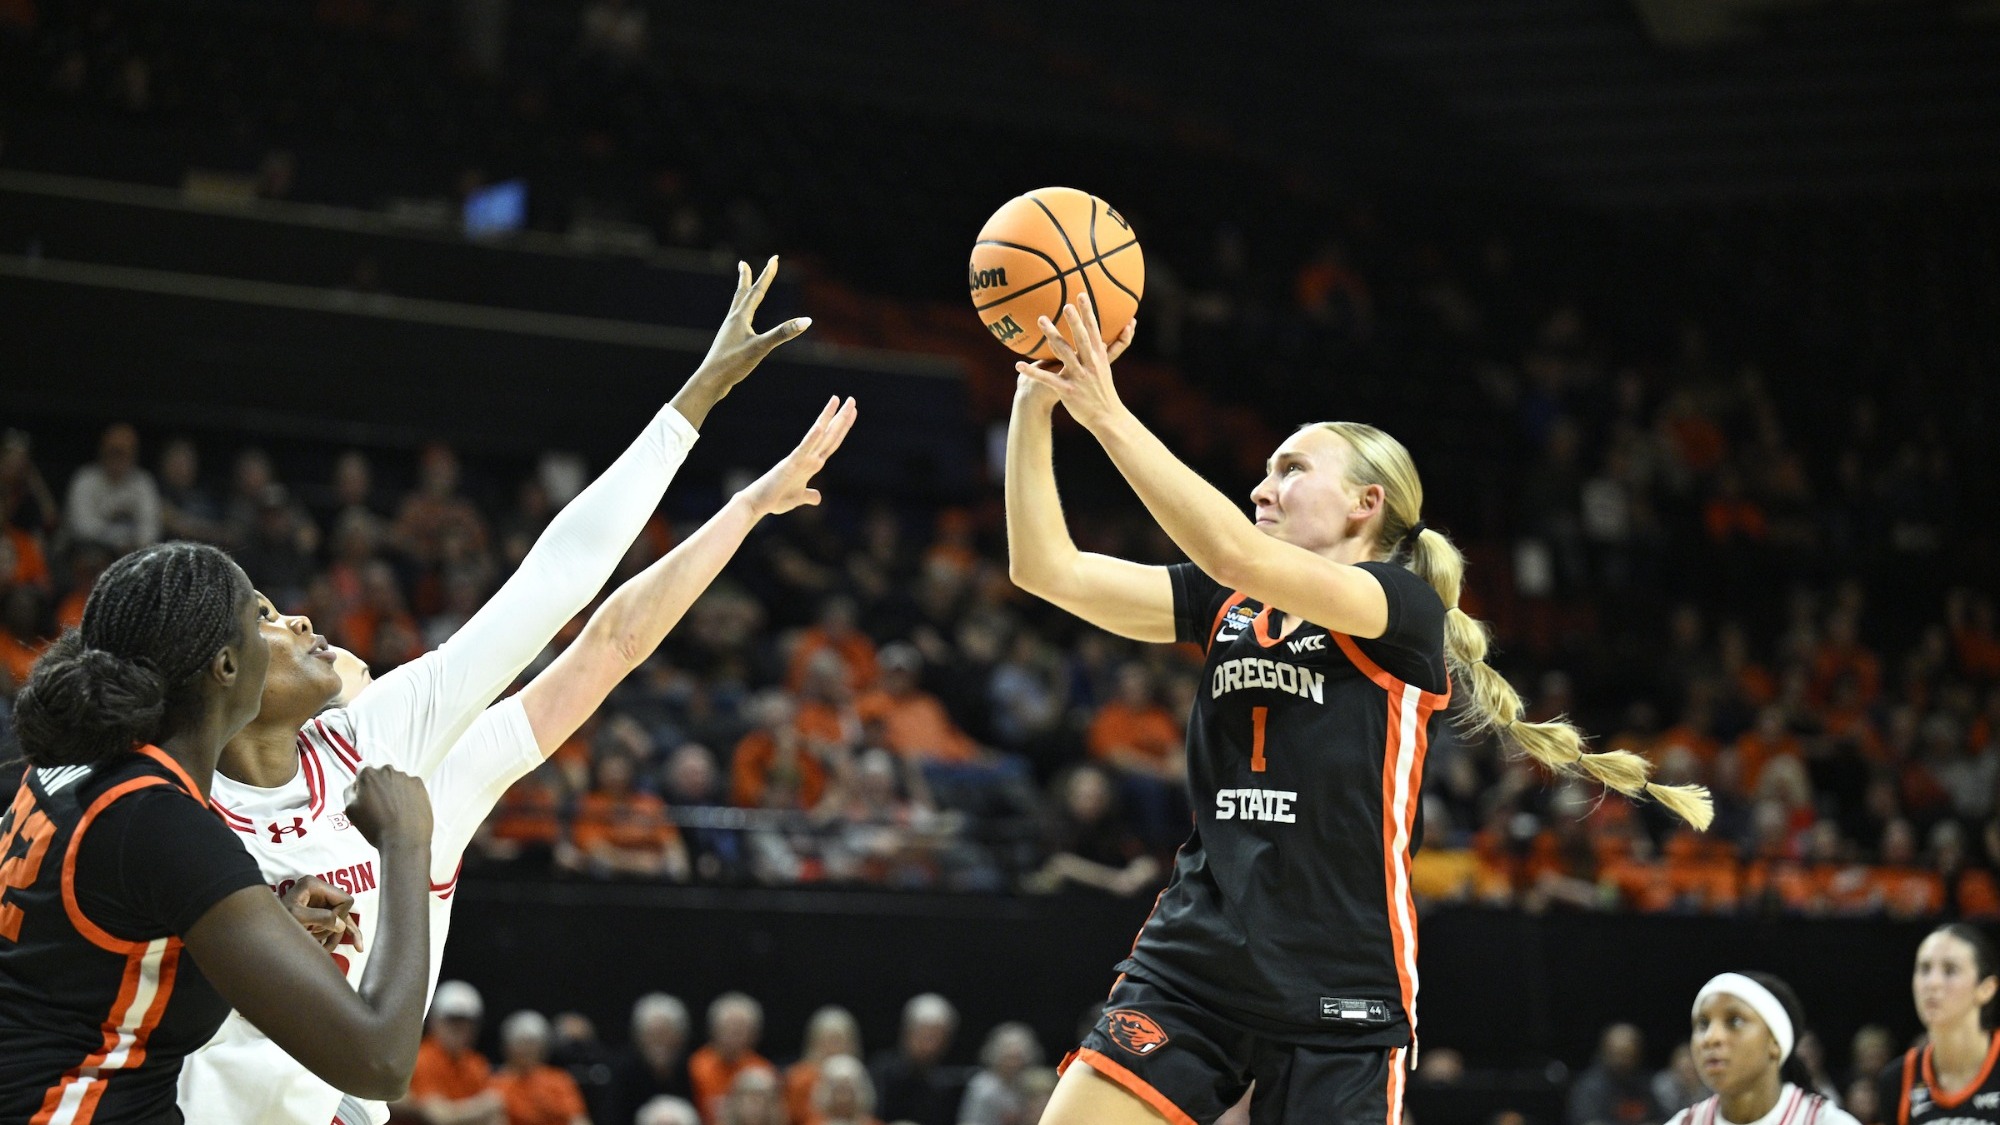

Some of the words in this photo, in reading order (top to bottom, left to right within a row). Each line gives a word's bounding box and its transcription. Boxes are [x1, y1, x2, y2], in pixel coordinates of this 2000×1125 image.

[1286, 634, 1326, 655] WCC
[1212, 657, 1325, 705] OREGON
[1251, 706, 1268, 772] 1
[1215, 788, 1298, 823] STATE
